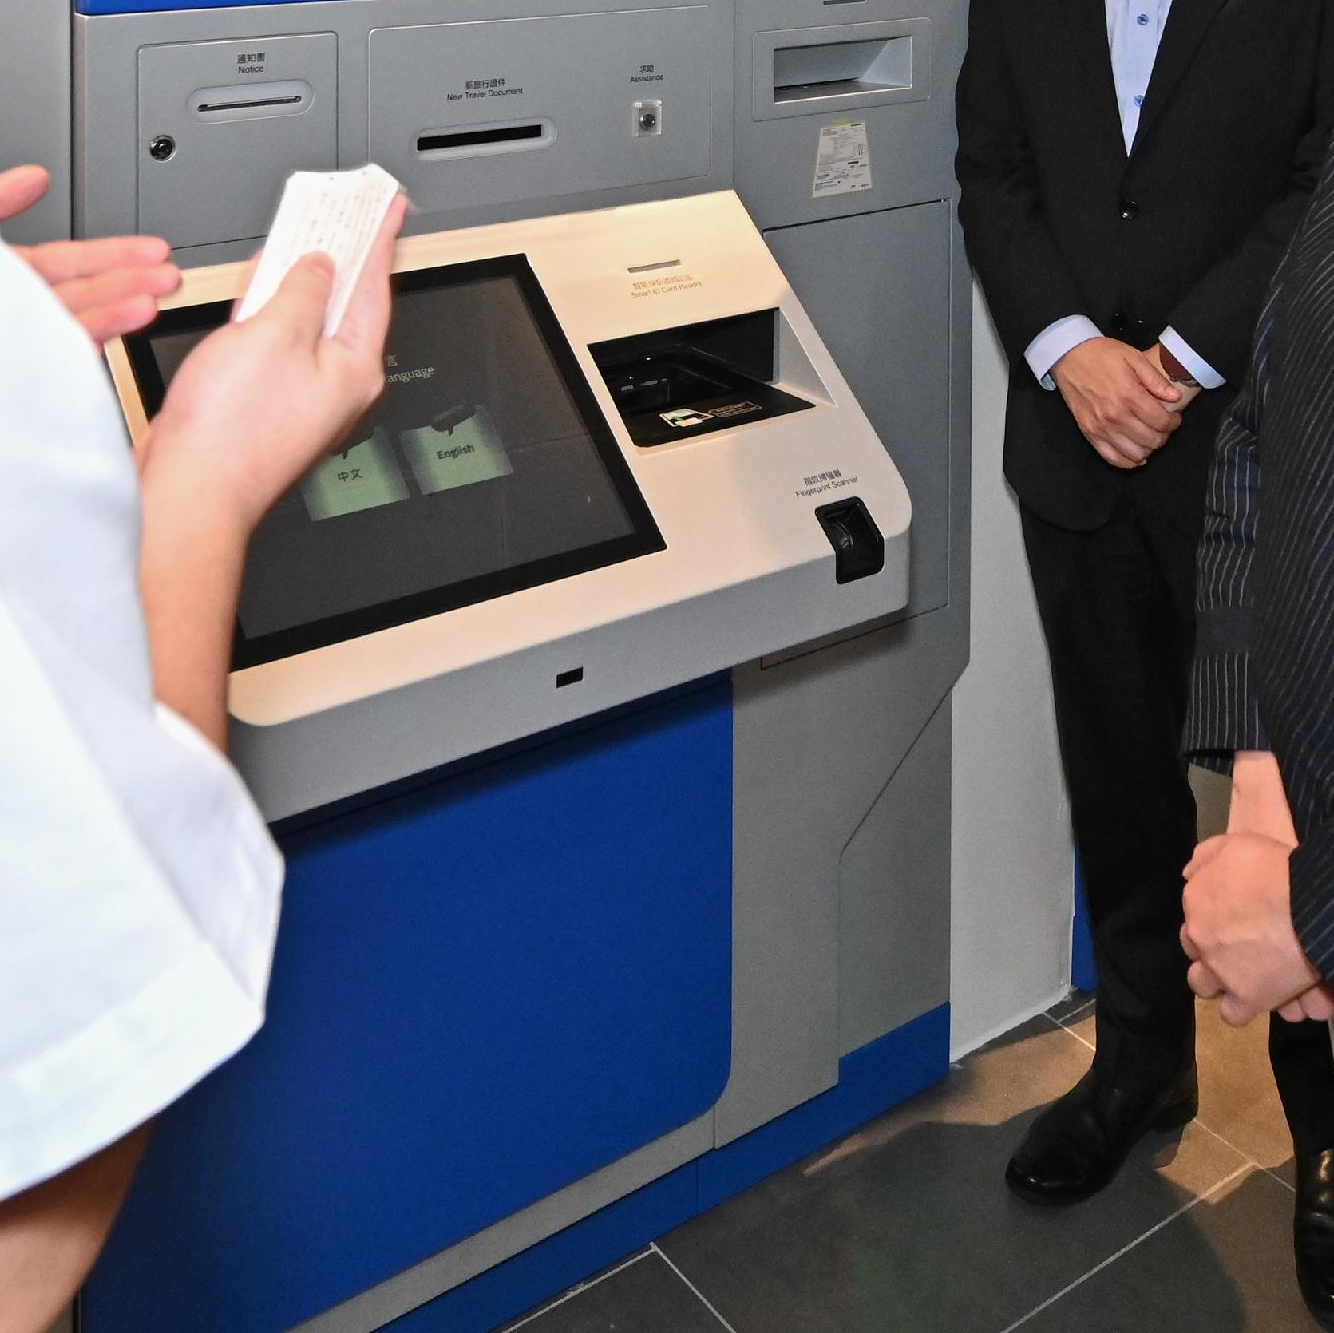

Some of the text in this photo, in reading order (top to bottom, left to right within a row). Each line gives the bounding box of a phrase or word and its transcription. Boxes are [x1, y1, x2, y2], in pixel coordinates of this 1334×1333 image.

[237, 52, 266, 64] 通知書
[238, 65, 264, 74] Notice
[446, 87, 524, 101] New Travel Document
[387, 366, 435, 384] anguage
[436, 444, 476, 460] English
[337, 467, 364, 483] 中文
